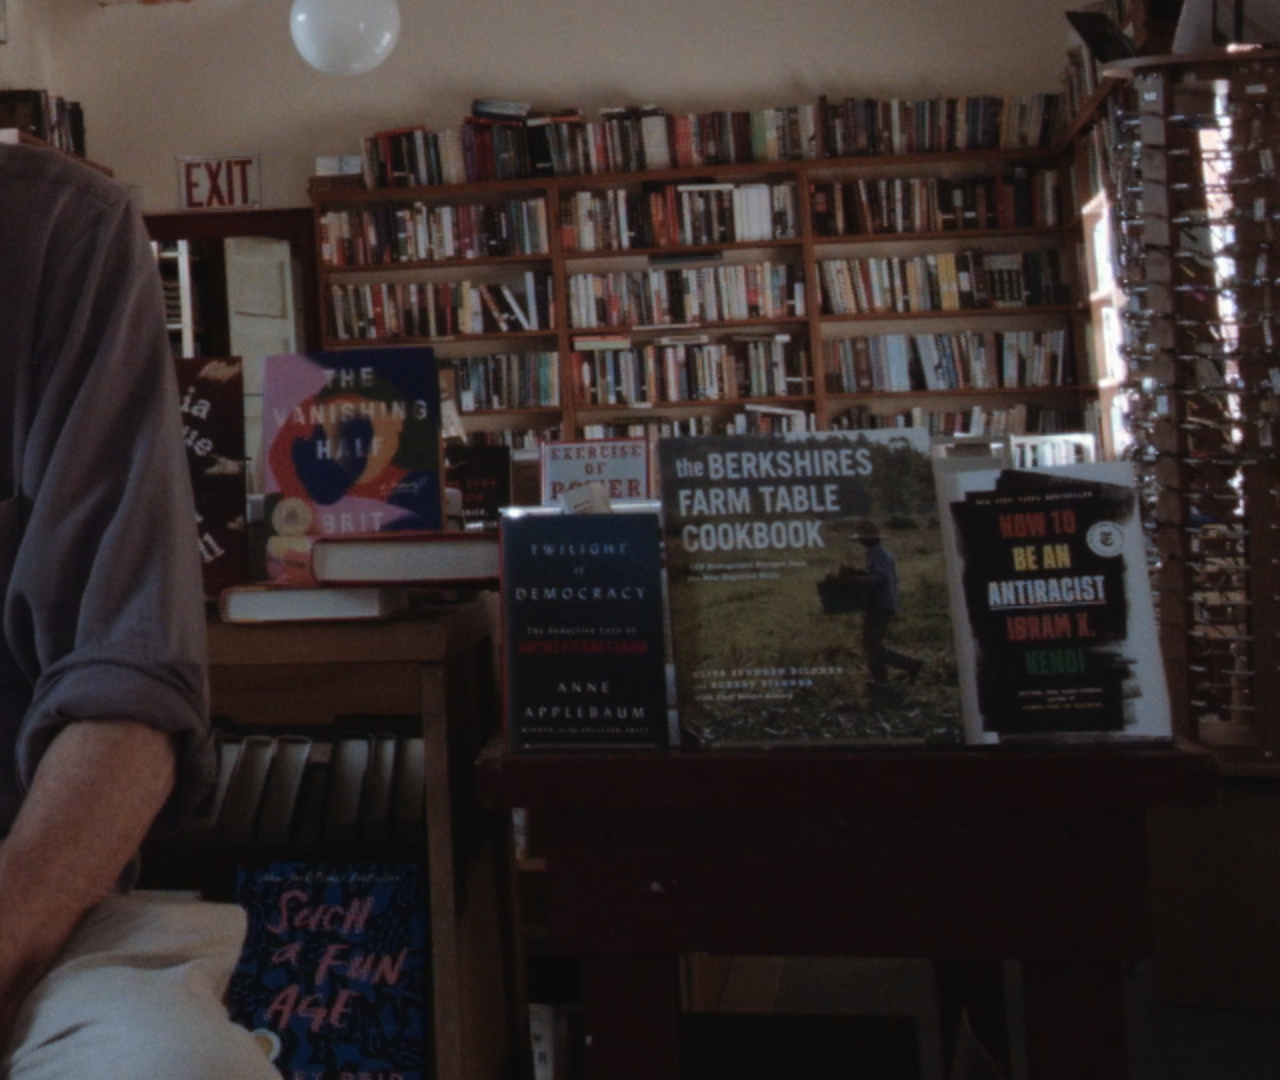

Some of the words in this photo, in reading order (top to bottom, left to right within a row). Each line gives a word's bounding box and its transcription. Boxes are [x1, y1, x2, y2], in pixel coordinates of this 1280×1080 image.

[184, 159, 253, 207] EXIT
[324, 366, 375, 388] THE
[180, 385, 211, 421] ia
[271, 399, 430, 427] VANISHING
[315, 436, 385, 461] HALF
[549, 445, 640, 462] EXERCISE
[583, 462, 607, 476] OF
[674, 456, 704, 478] the
[706, 447, 874, 481] BERKSHIRES
[549, 478, 641, 502] PER
[678, 486, 751, 518] FARM
[757, 483, 841, 515] TABLE
[681, 519, 826, 553] COOKBOOK
[998, 511, 1047, 539] HOW
[1051, 508, 1077, 535] TO
[529, 543, 628, 557] TWILIGHT
[1011, 544, 1039, 572] BE
[1042, 542, 1072, 570] AN
[514, 586, 646, 602] DEMOCRACY
[987, 575, 1106, 607] ANTIRACIST
[1005, 612, 1073, 642] IBRAM
[1077, 611, 1097, 638] X.
[1024, 647, 1087, 676] KENDI
[556, 680, 610, 694] ANNE
[523, 705, 646, 720] APPLEBAUM
[262, 983, 364, 1034] AGE
